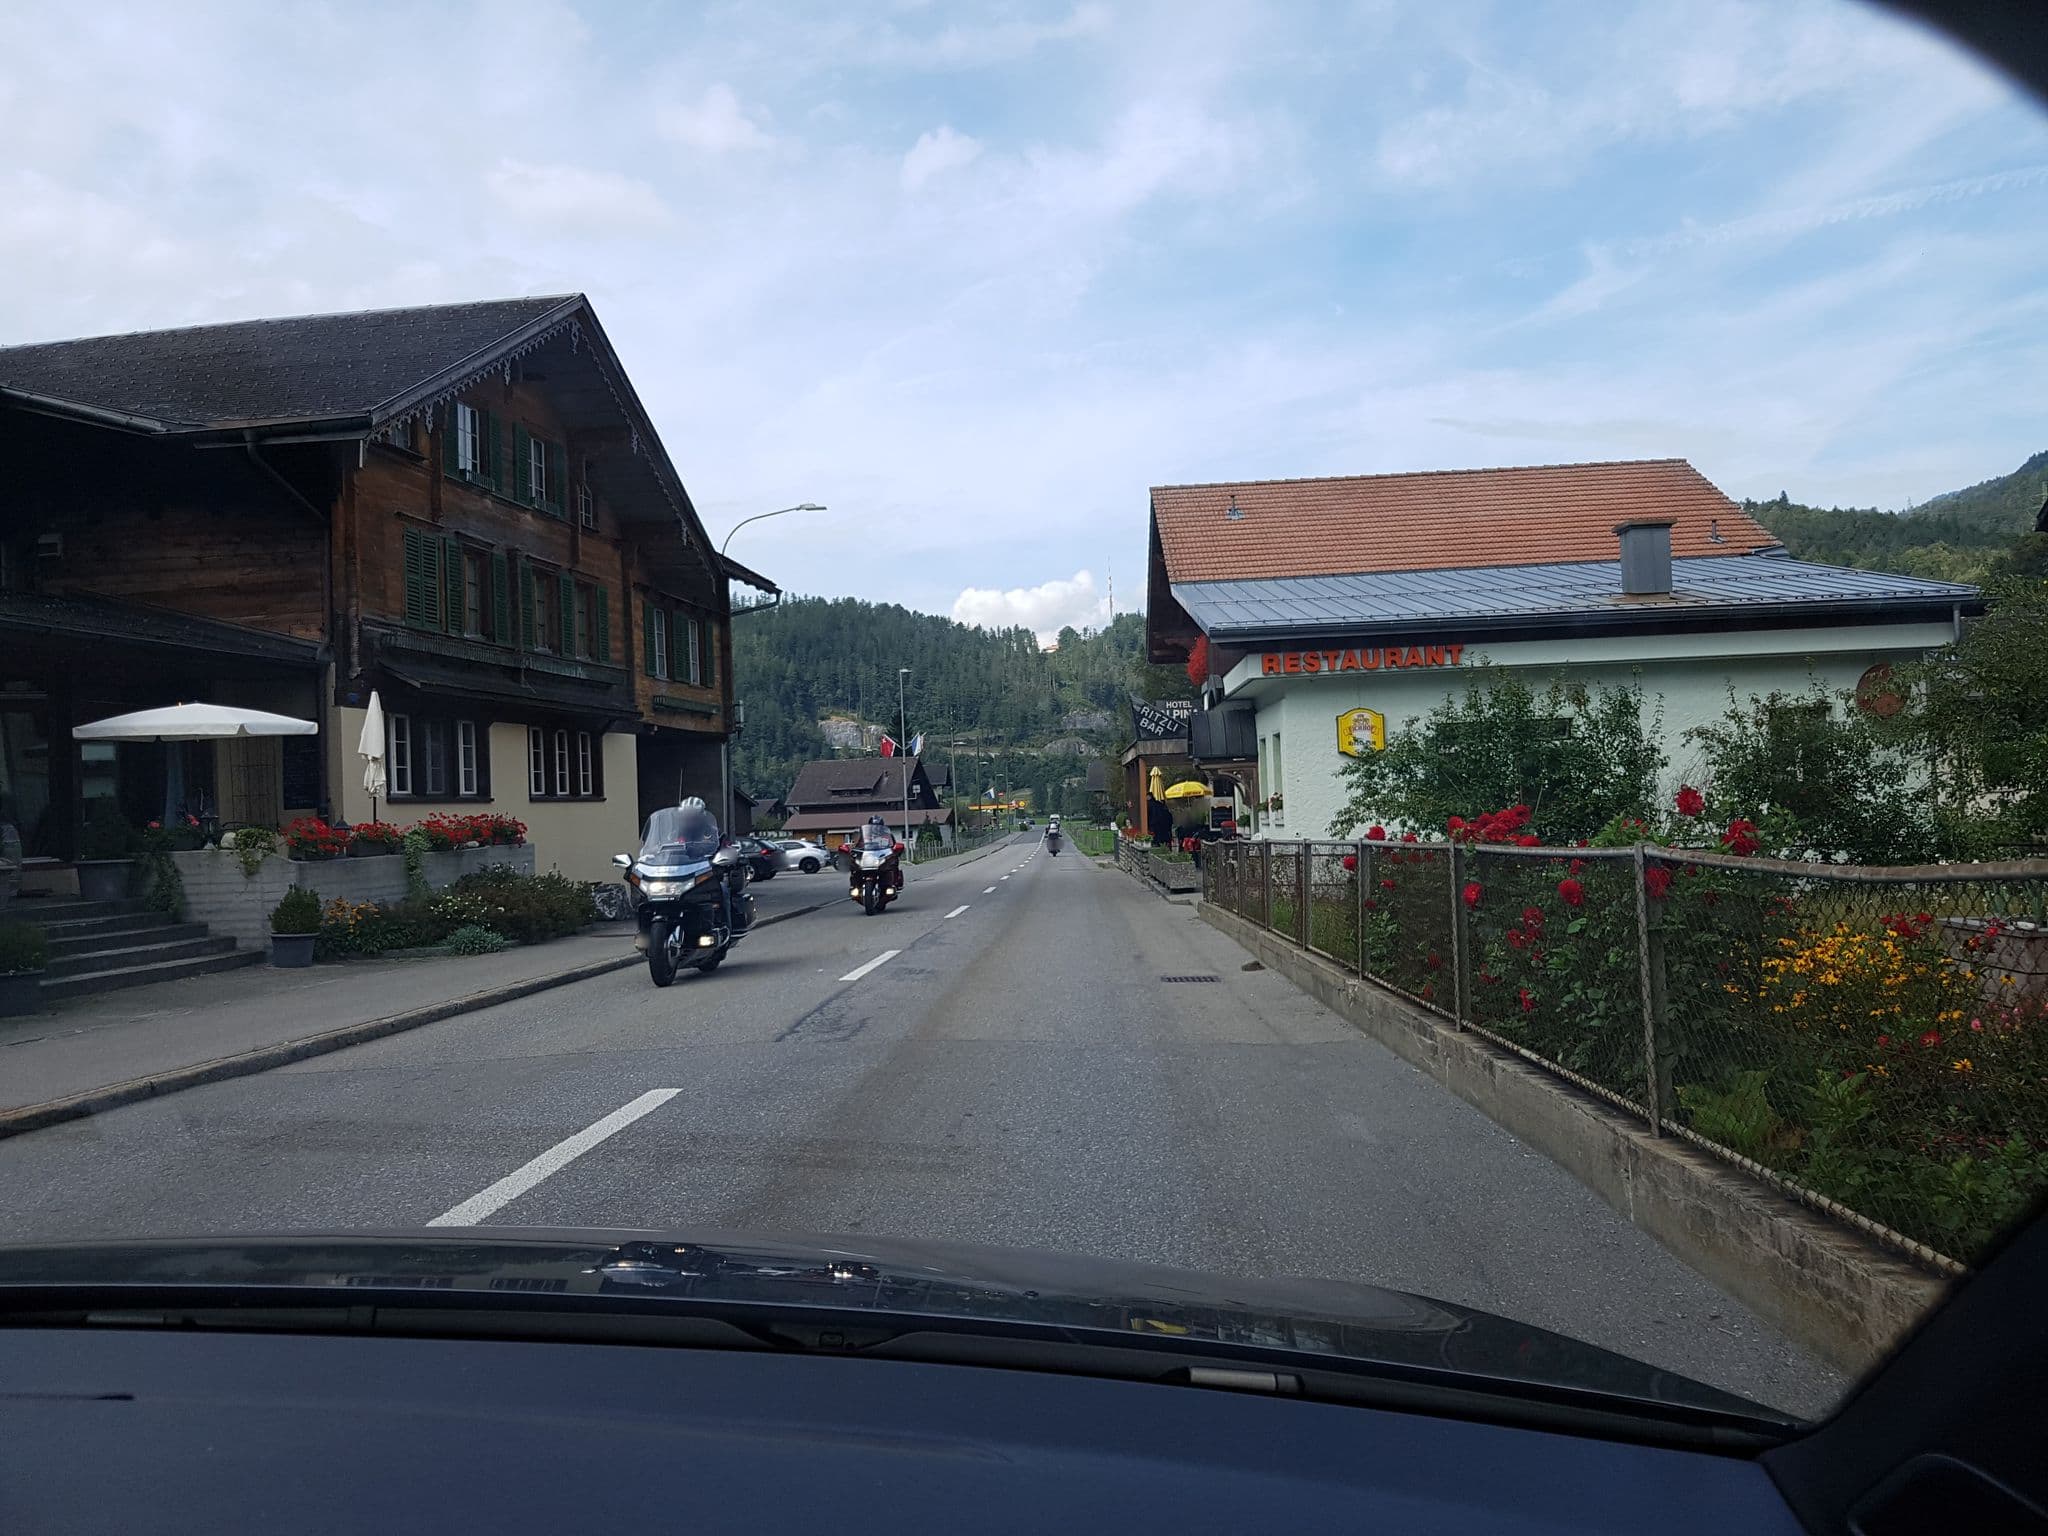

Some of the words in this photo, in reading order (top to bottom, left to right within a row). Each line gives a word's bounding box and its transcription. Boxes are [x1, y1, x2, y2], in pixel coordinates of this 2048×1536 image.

[1261, 644, 1464, 675] RESTAURANT
[1166, 700, 1192, 709] HOTEL
[1139, 718, 1164, 736] BAR
[1140, 706, 1179, 732] RITZLI
